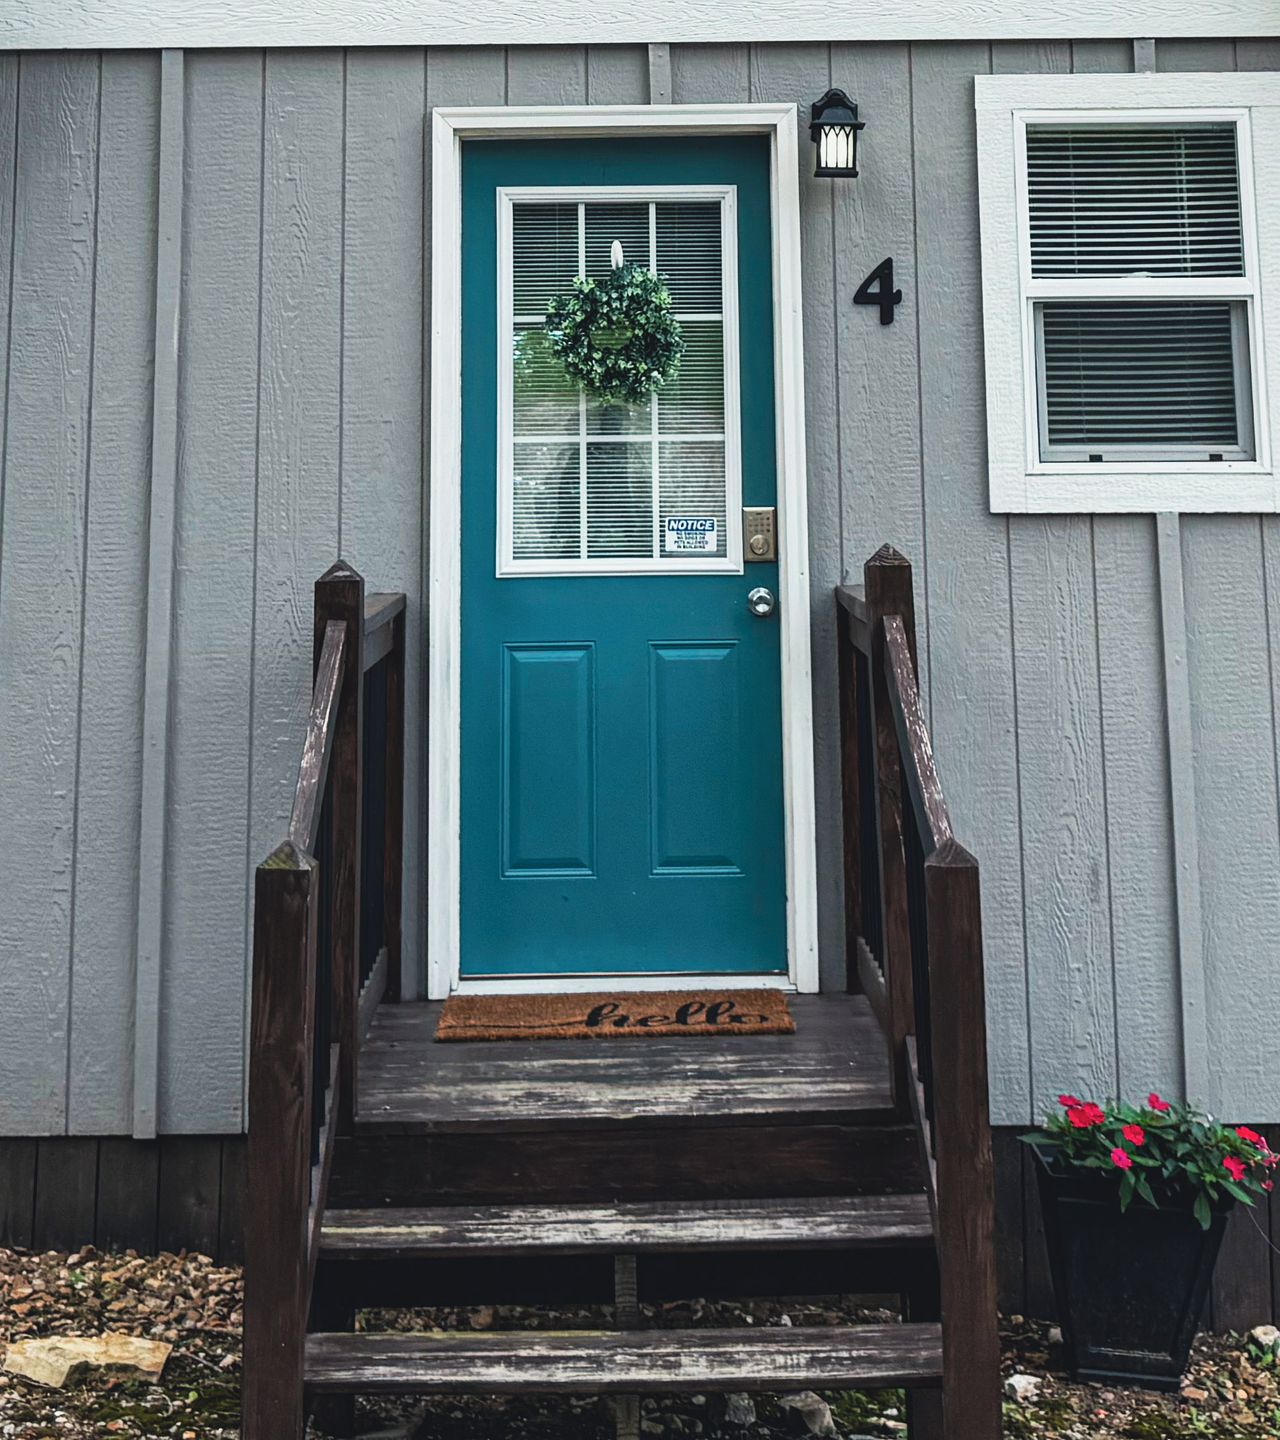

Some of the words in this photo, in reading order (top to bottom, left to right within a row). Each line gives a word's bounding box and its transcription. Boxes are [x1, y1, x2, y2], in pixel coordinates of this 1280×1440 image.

[853, 257, 902, 325] 4
[669, 520, 714, 530] NOTICE
[585, 1001, 768, 1029] hello
